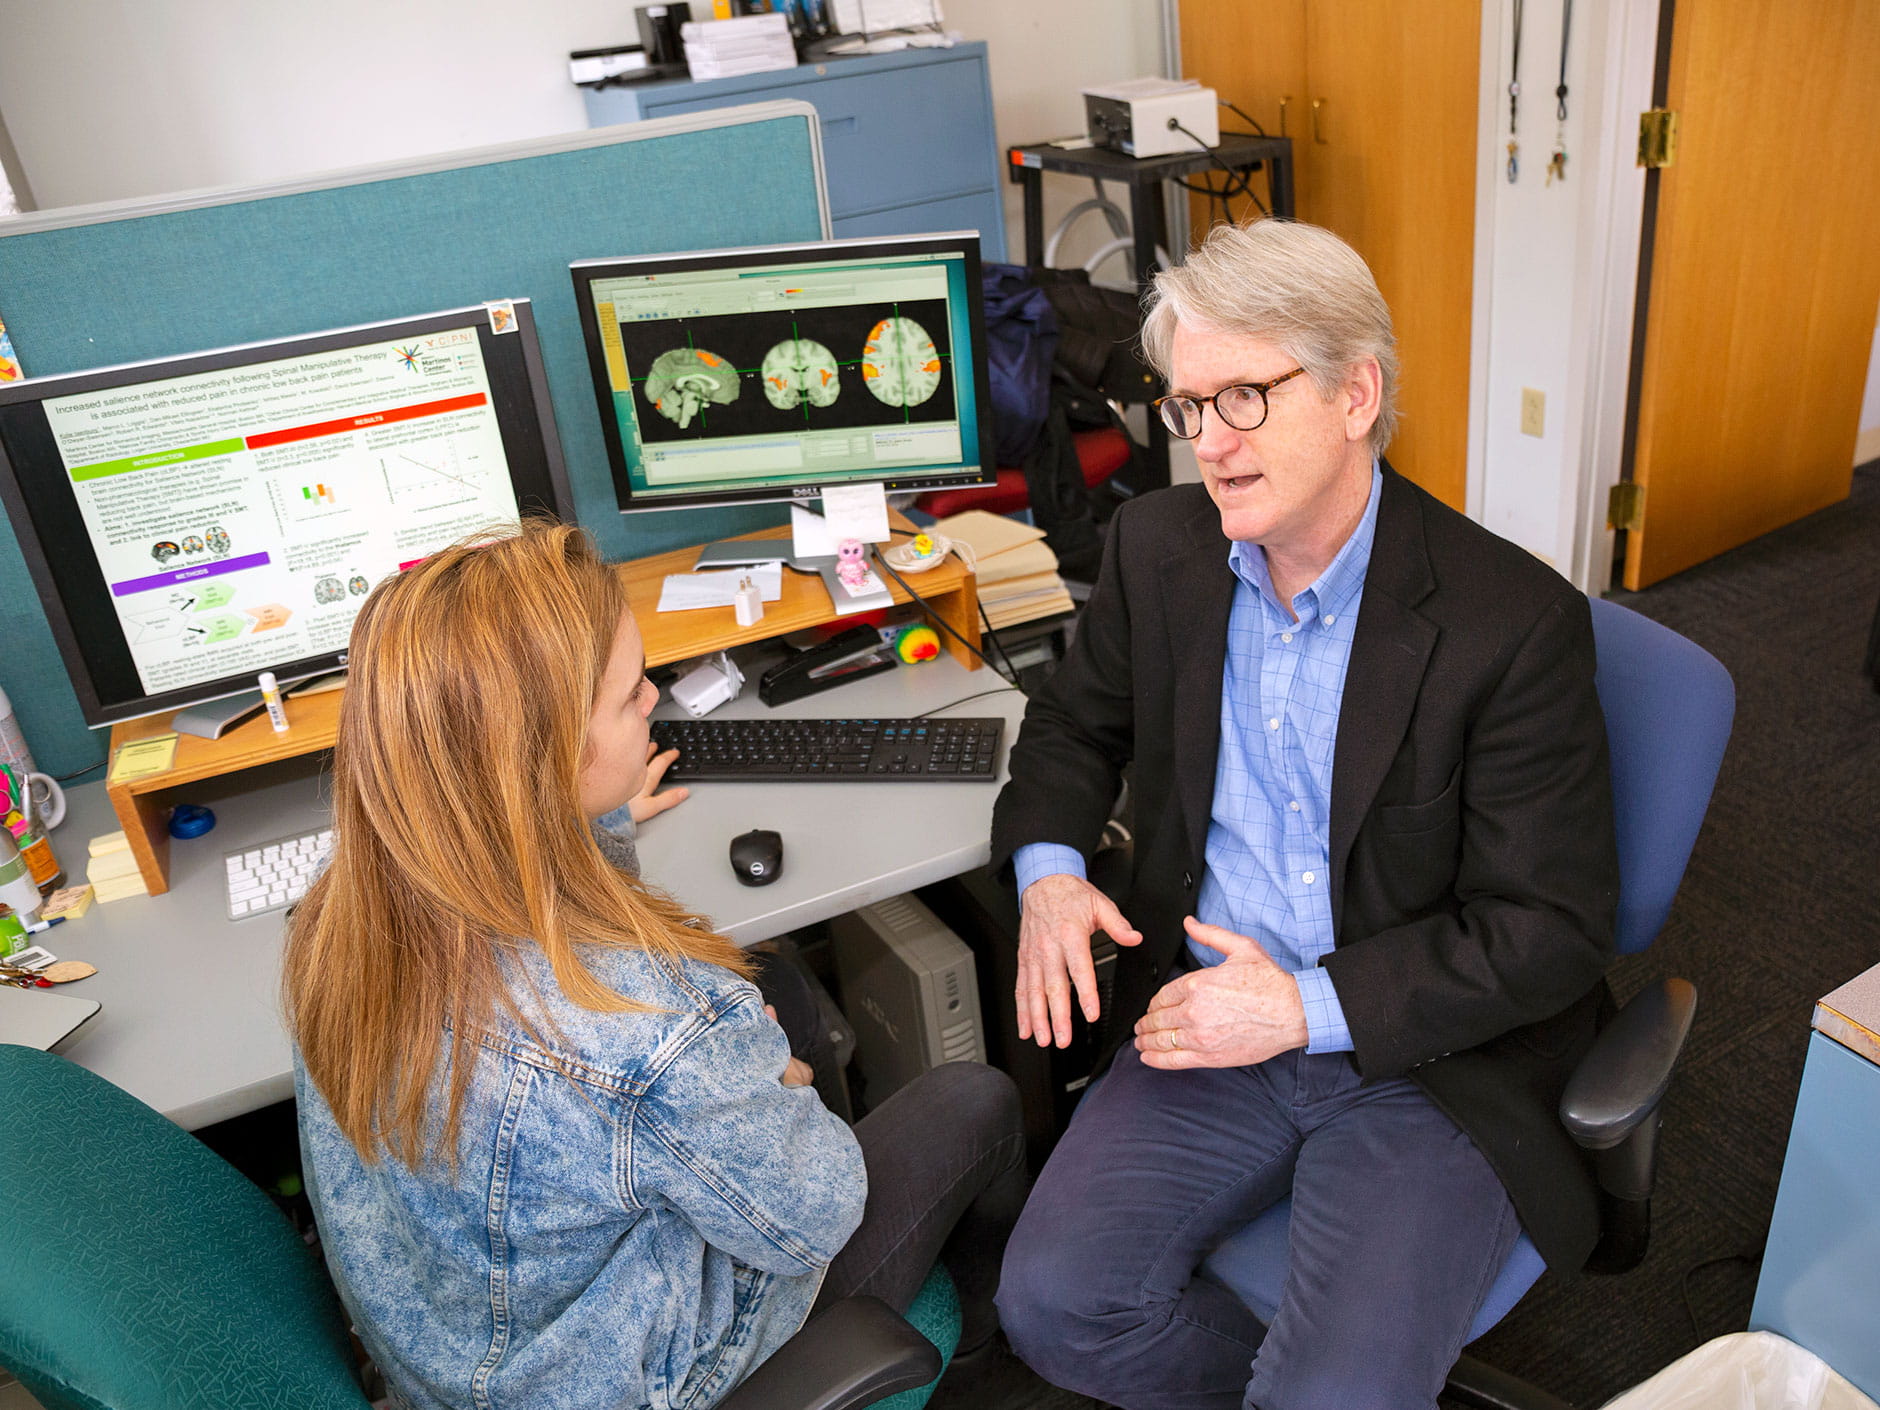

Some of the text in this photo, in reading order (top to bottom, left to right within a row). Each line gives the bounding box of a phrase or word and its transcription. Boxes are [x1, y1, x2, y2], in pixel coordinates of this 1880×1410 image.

[422, 357, 451, 366] Martinos
[423, 365, 445, 373] Center
[55, 351, 386, 413] Increased salience network connectivity following Spinal Manipulative Therapy
[101, 404, 148, 417] associated
[151, 400, 168, 408] with
[171, 393, 206, 404] reduced
[209, 391, 227, 399] pain
[239, 383, 269, 393] chronic
[288, 376, 307, 384] back
[310, 373, 328, 381] pain
[330, 367, 362, 378] patients
[354, 416, 384, 425] RESULTS
[108, 482, 143, 491] connectivity
[793, 488, 820, 497] DELL
[174, 569, 209, 579] METHODS
